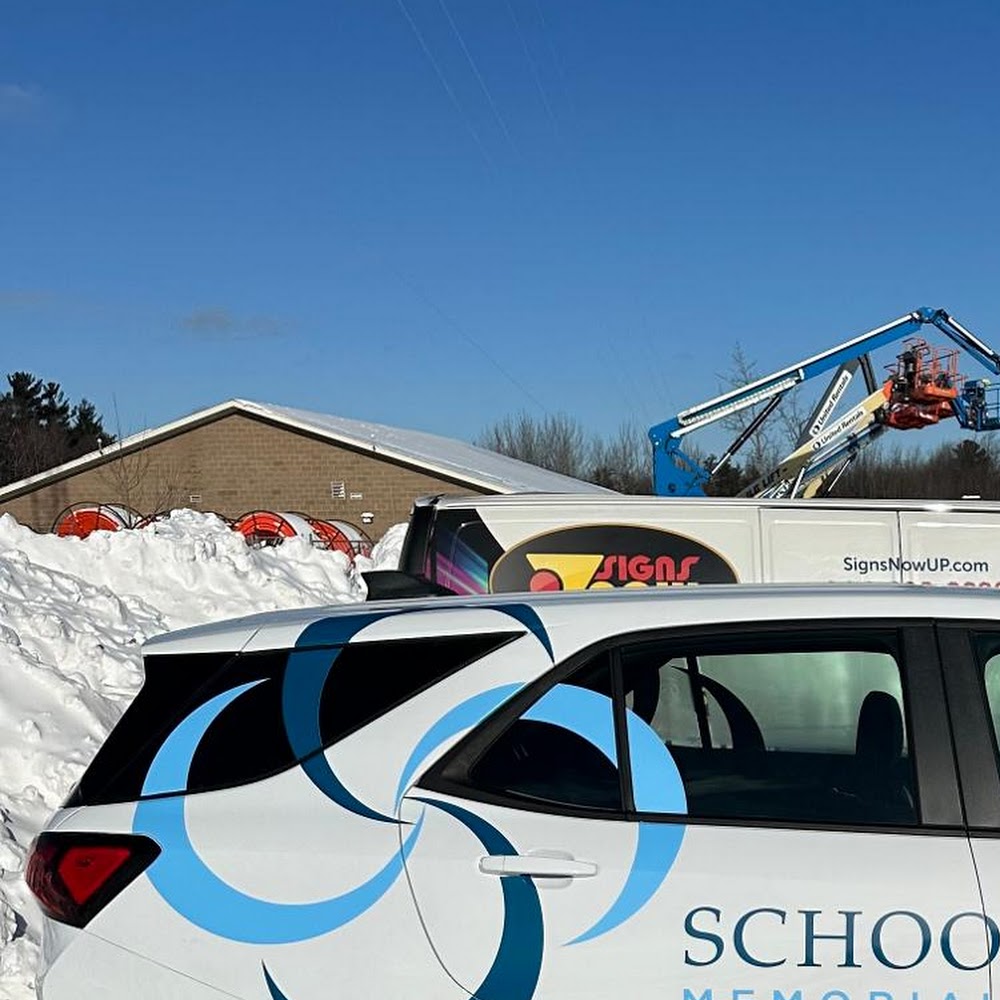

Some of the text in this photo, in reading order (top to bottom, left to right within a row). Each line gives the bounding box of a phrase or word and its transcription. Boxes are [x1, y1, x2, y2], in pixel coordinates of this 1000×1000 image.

[818, 375, 849, 425] United Rentals
[821, 410, 864, 444] United Rentals
[594, 555, 700, 581] SIGNS
[843, 556, 989, 574] SignsNowUP.com
